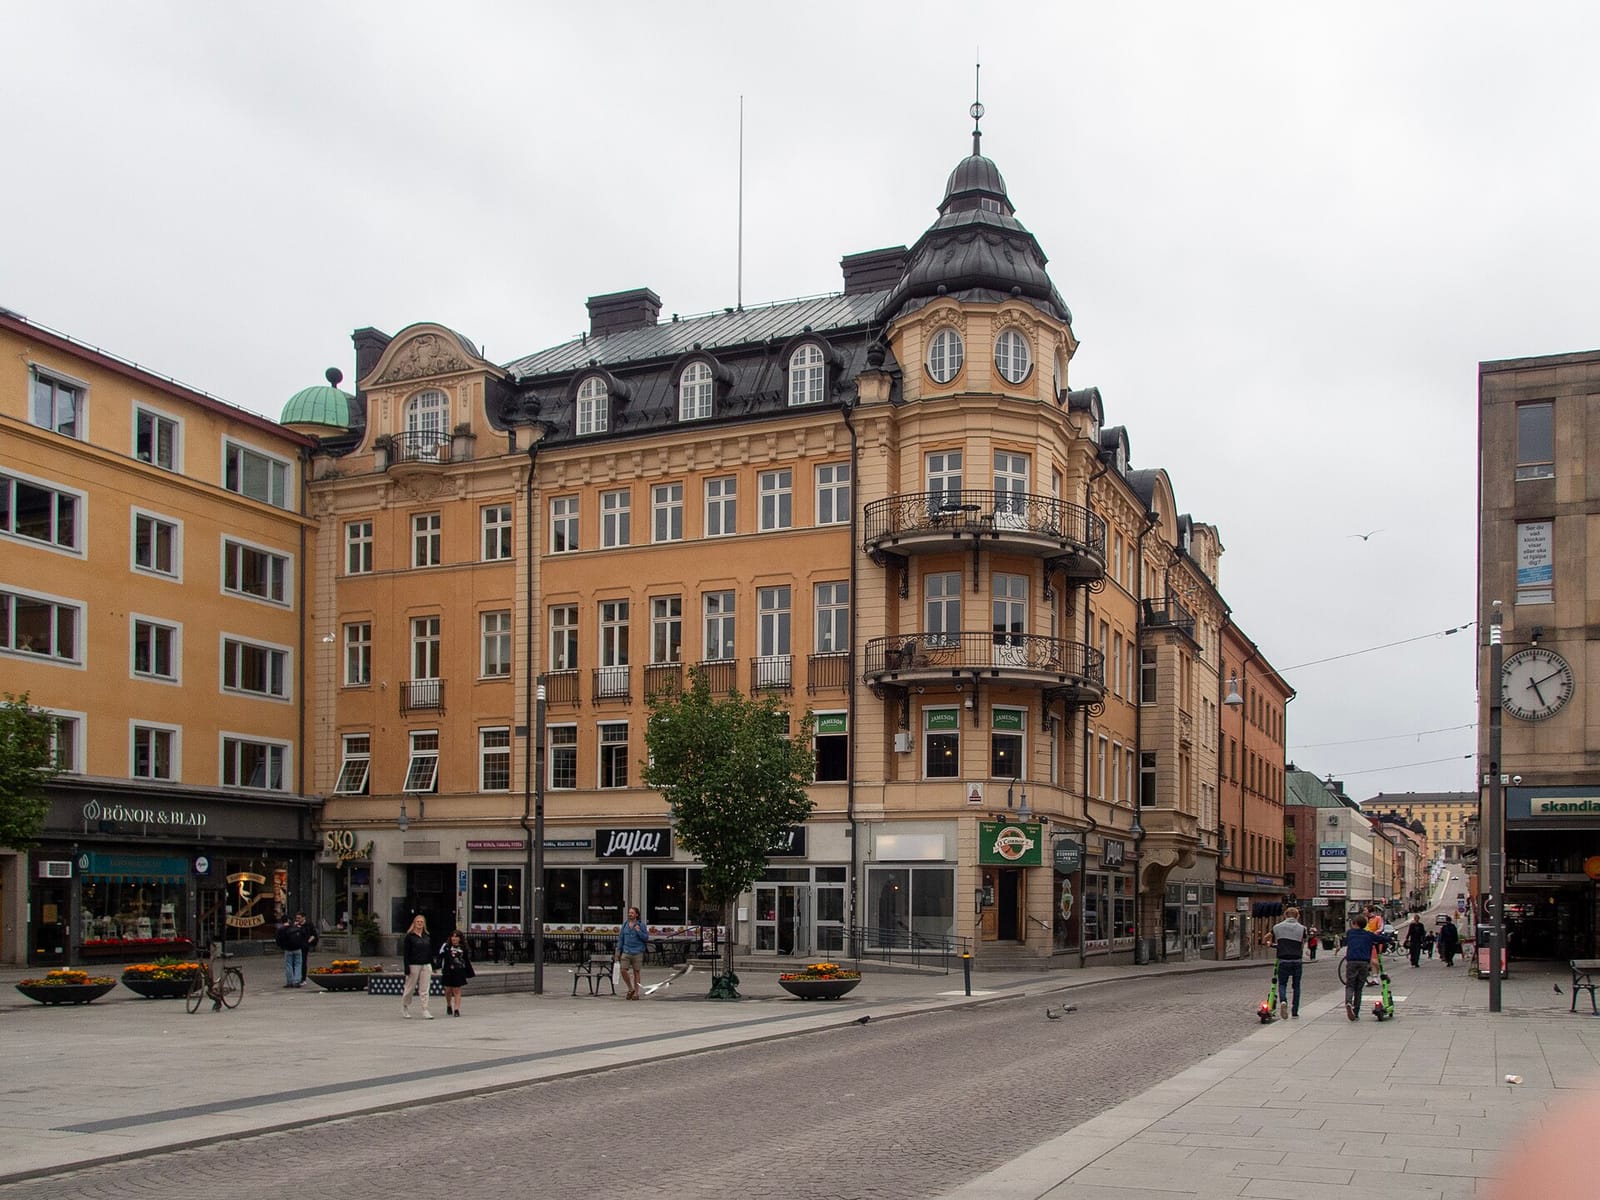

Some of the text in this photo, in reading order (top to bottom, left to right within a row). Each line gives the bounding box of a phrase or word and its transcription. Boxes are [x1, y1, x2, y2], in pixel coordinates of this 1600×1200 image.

[930, 714, 955, 723] JAMESON
[995, 714, 1019, 723] JAMESON
[1541, 800, 1600, 812] skandia
[103, 804, 206, 826] BÖNOR & BLAD
[327, 830, 353, 850] SKO
